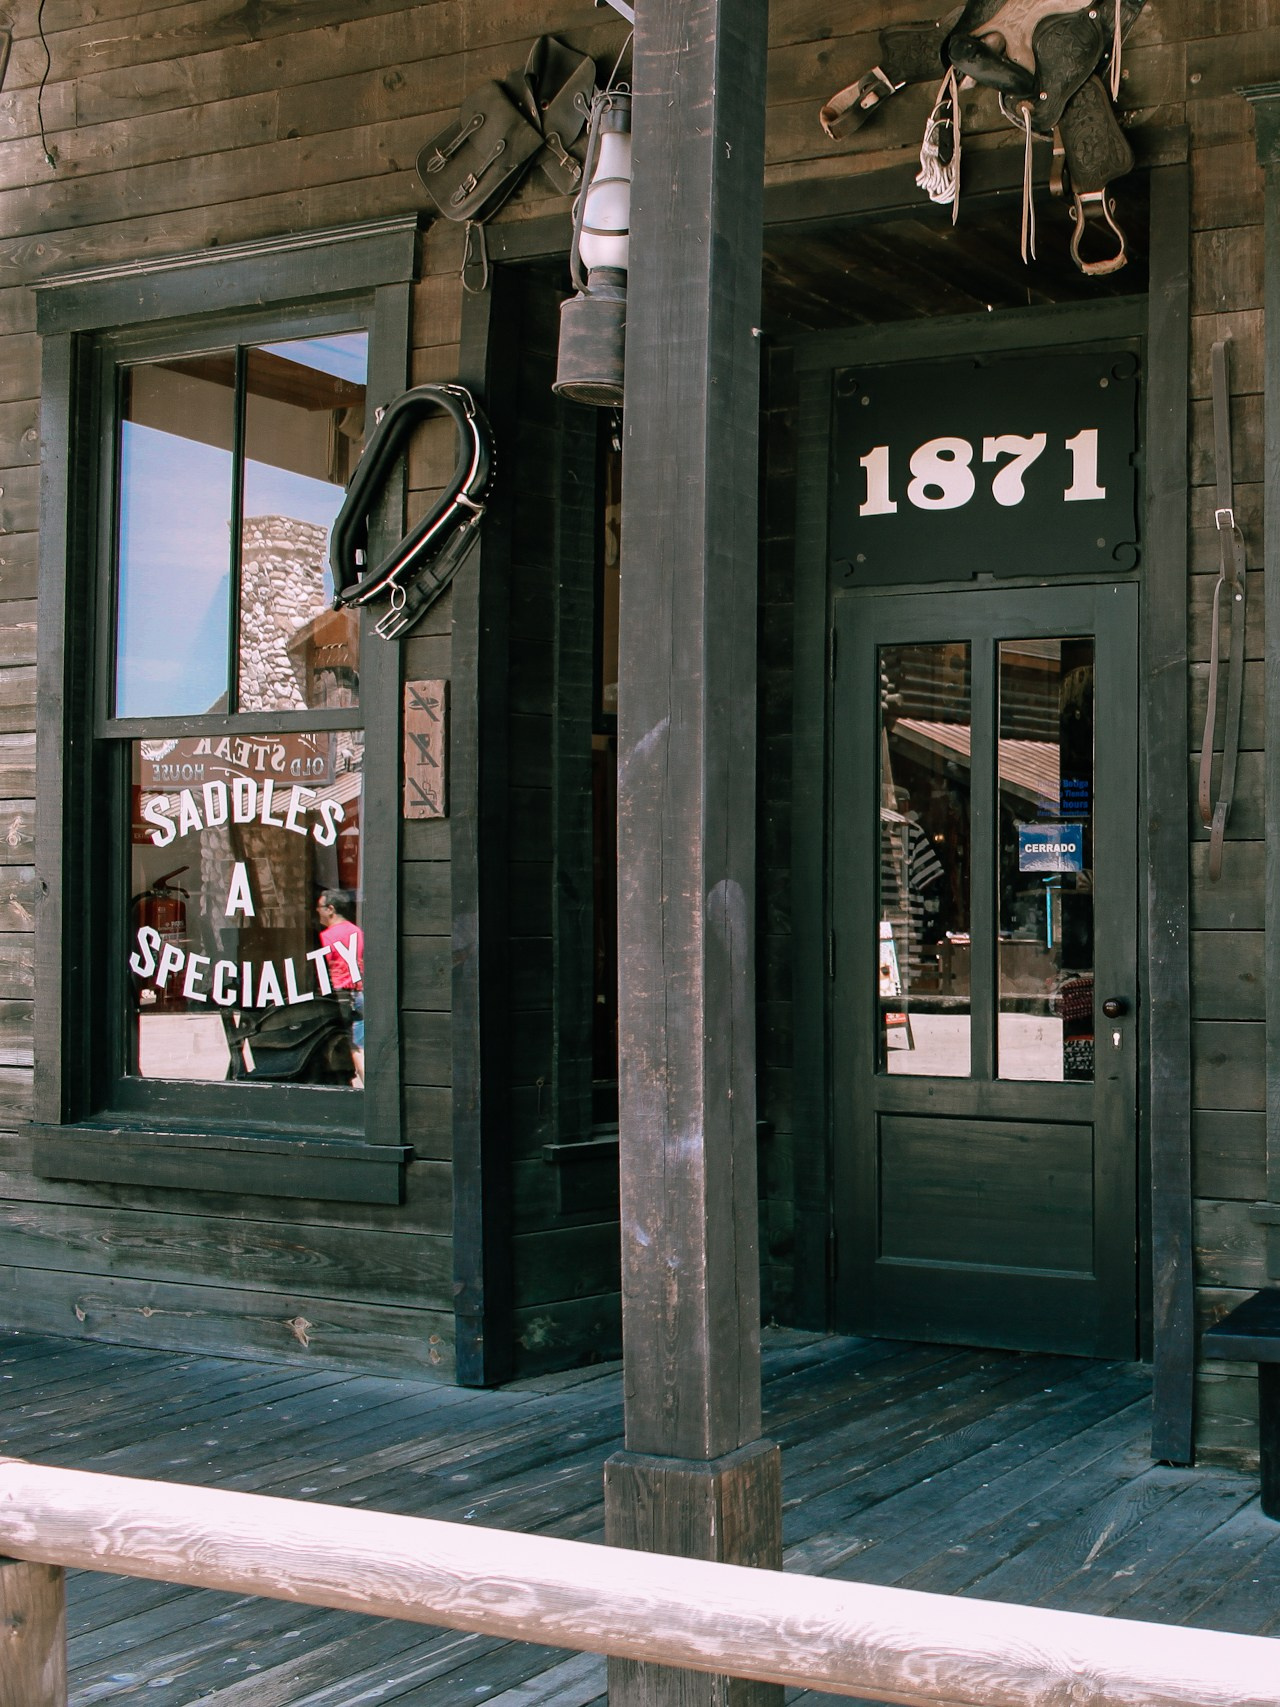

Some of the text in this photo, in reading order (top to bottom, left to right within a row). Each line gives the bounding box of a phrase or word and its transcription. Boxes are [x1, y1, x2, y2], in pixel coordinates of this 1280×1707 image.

[860, 429, 1106, 517] 1871
[144, 777, 344, 847] SADDLES
[1025, 843, 1076, 853] CERRADO
[225, 862, 255, 916] A
[129, 926, 362, 1008] SPECIALTY
